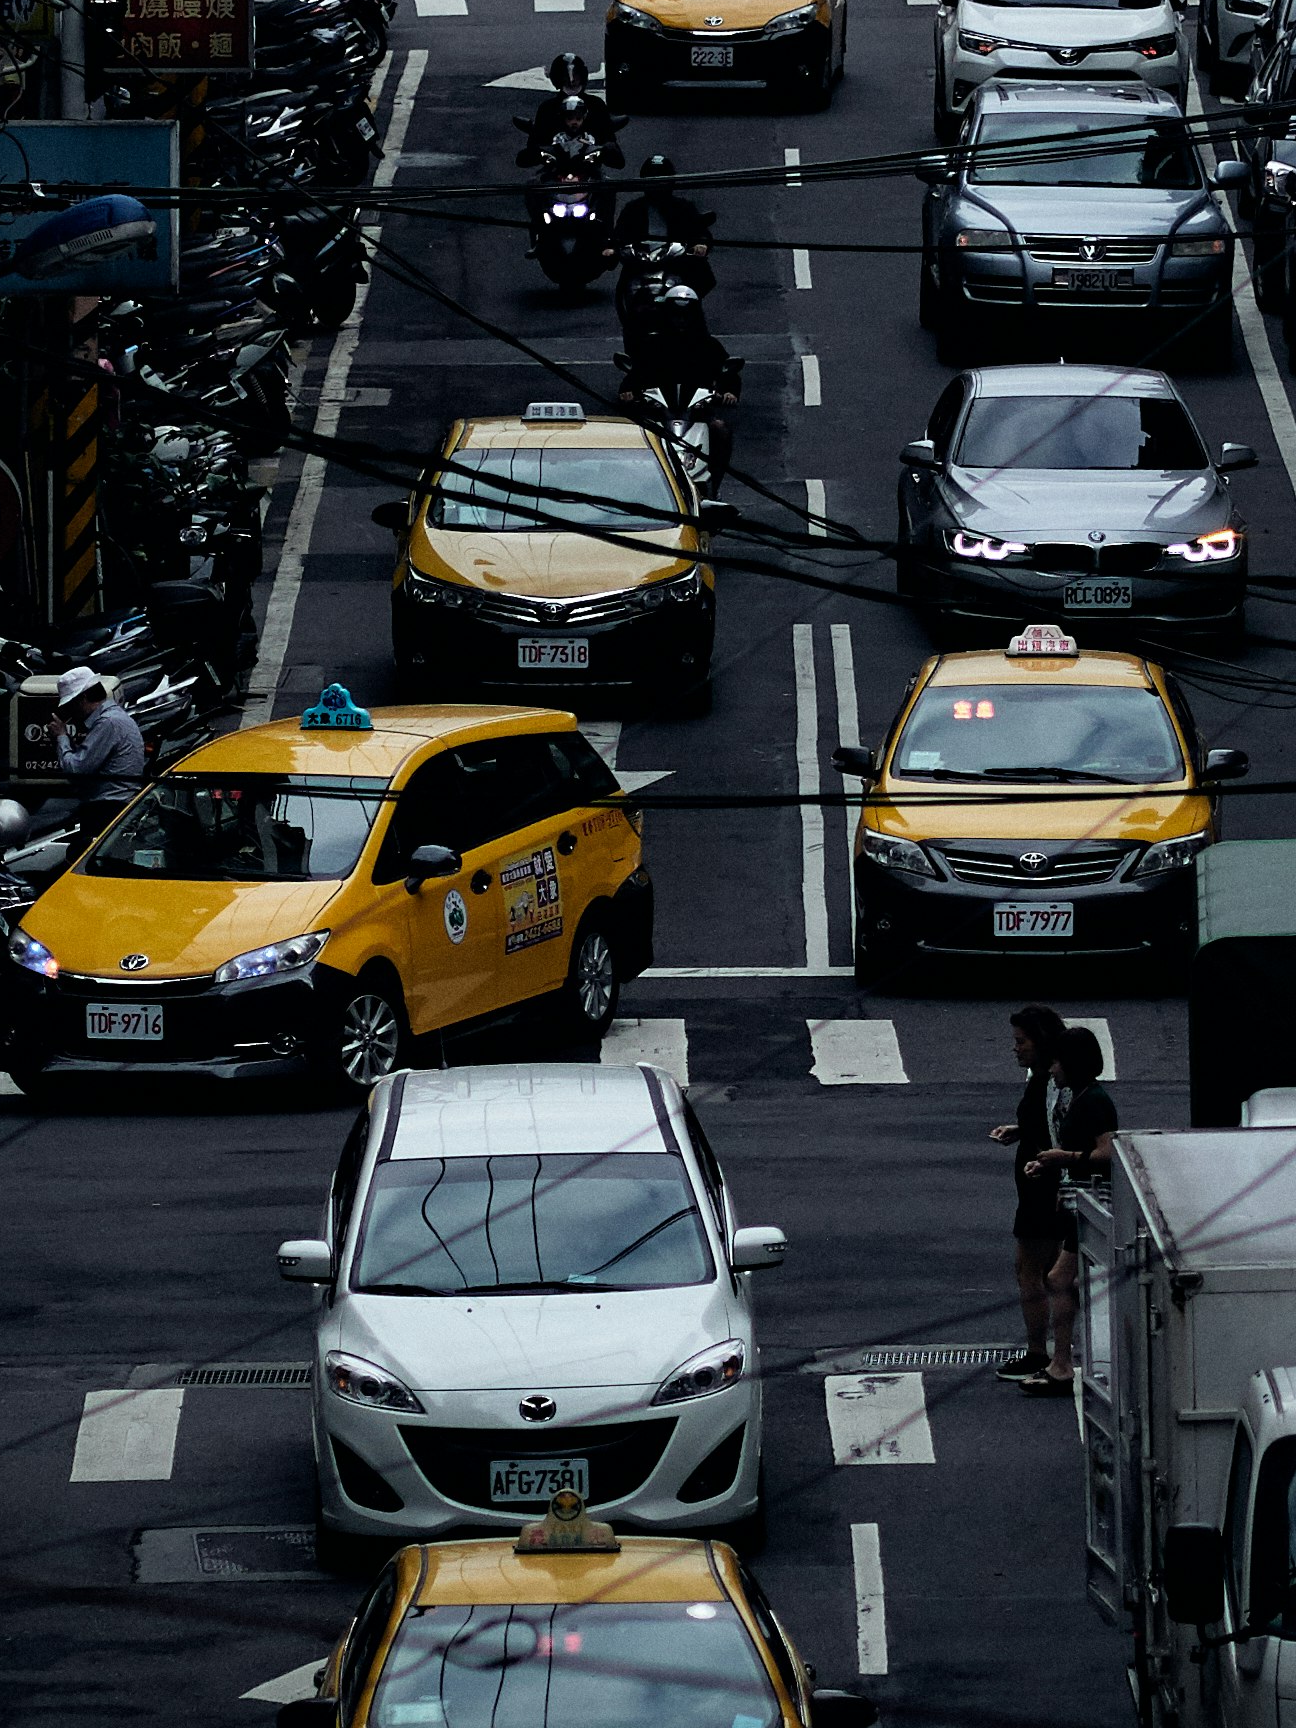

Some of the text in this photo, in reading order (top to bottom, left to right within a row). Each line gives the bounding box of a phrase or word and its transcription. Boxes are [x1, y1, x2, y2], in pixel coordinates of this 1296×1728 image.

[518, 641, 589, 666] TDF-7318
[995, 910, 1073, 933] TDF-7977
[88, 1012, 162, 1036] TDF-9716
